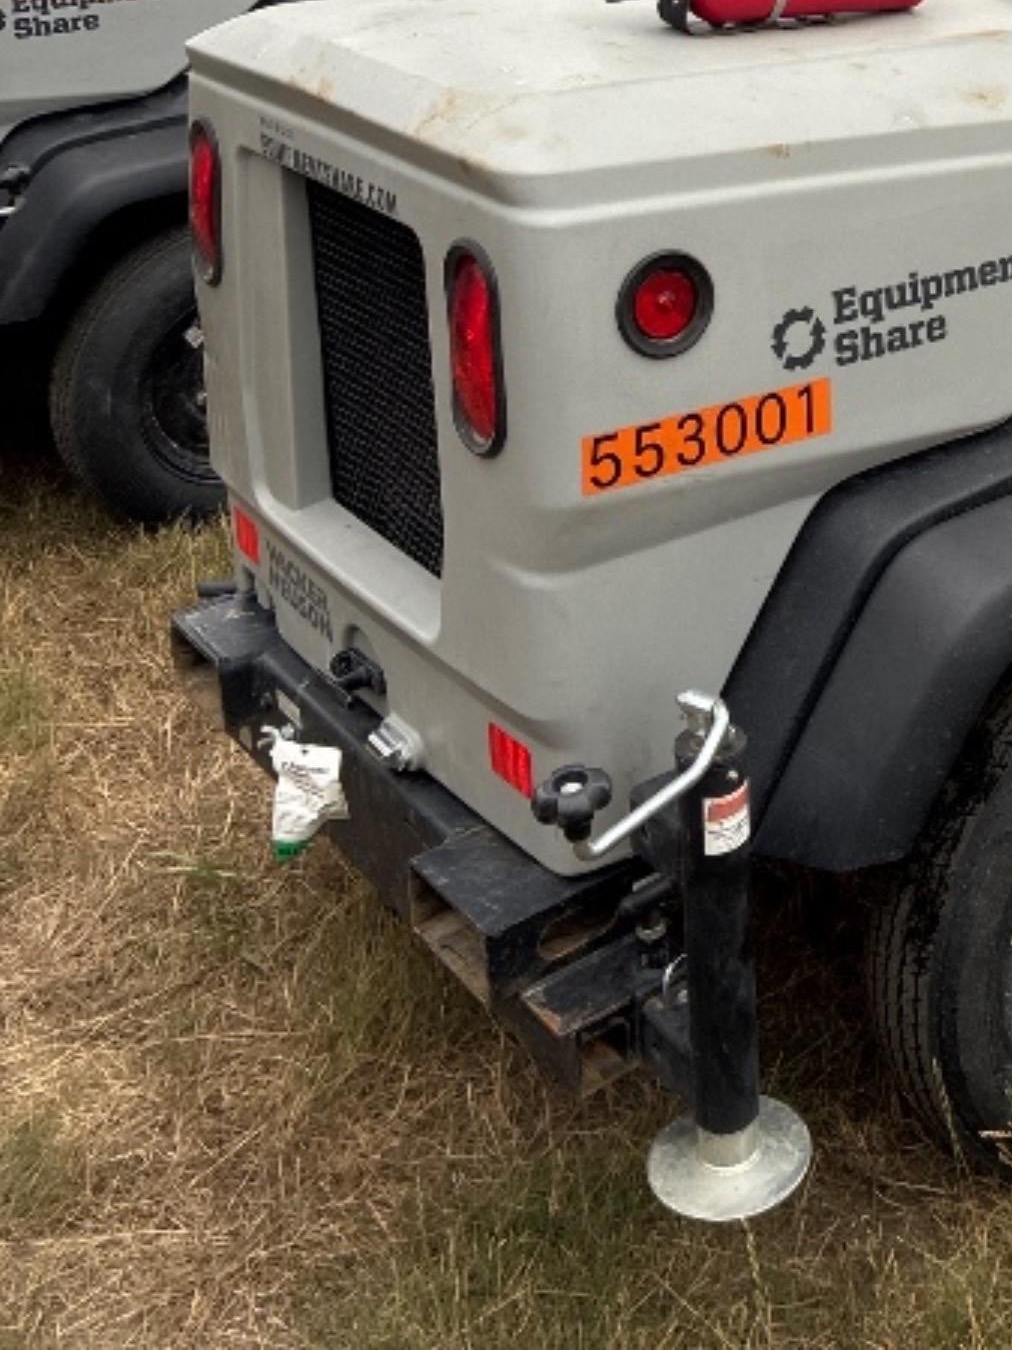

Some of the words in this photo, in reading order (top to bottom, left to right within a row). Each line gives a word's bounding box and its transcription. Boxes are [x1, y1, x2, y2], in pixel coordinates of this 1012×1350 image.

[14, 14, 99, 39] Share
[834, 315, 947, 366] Share
[589, 384, 820, 489] 553001
